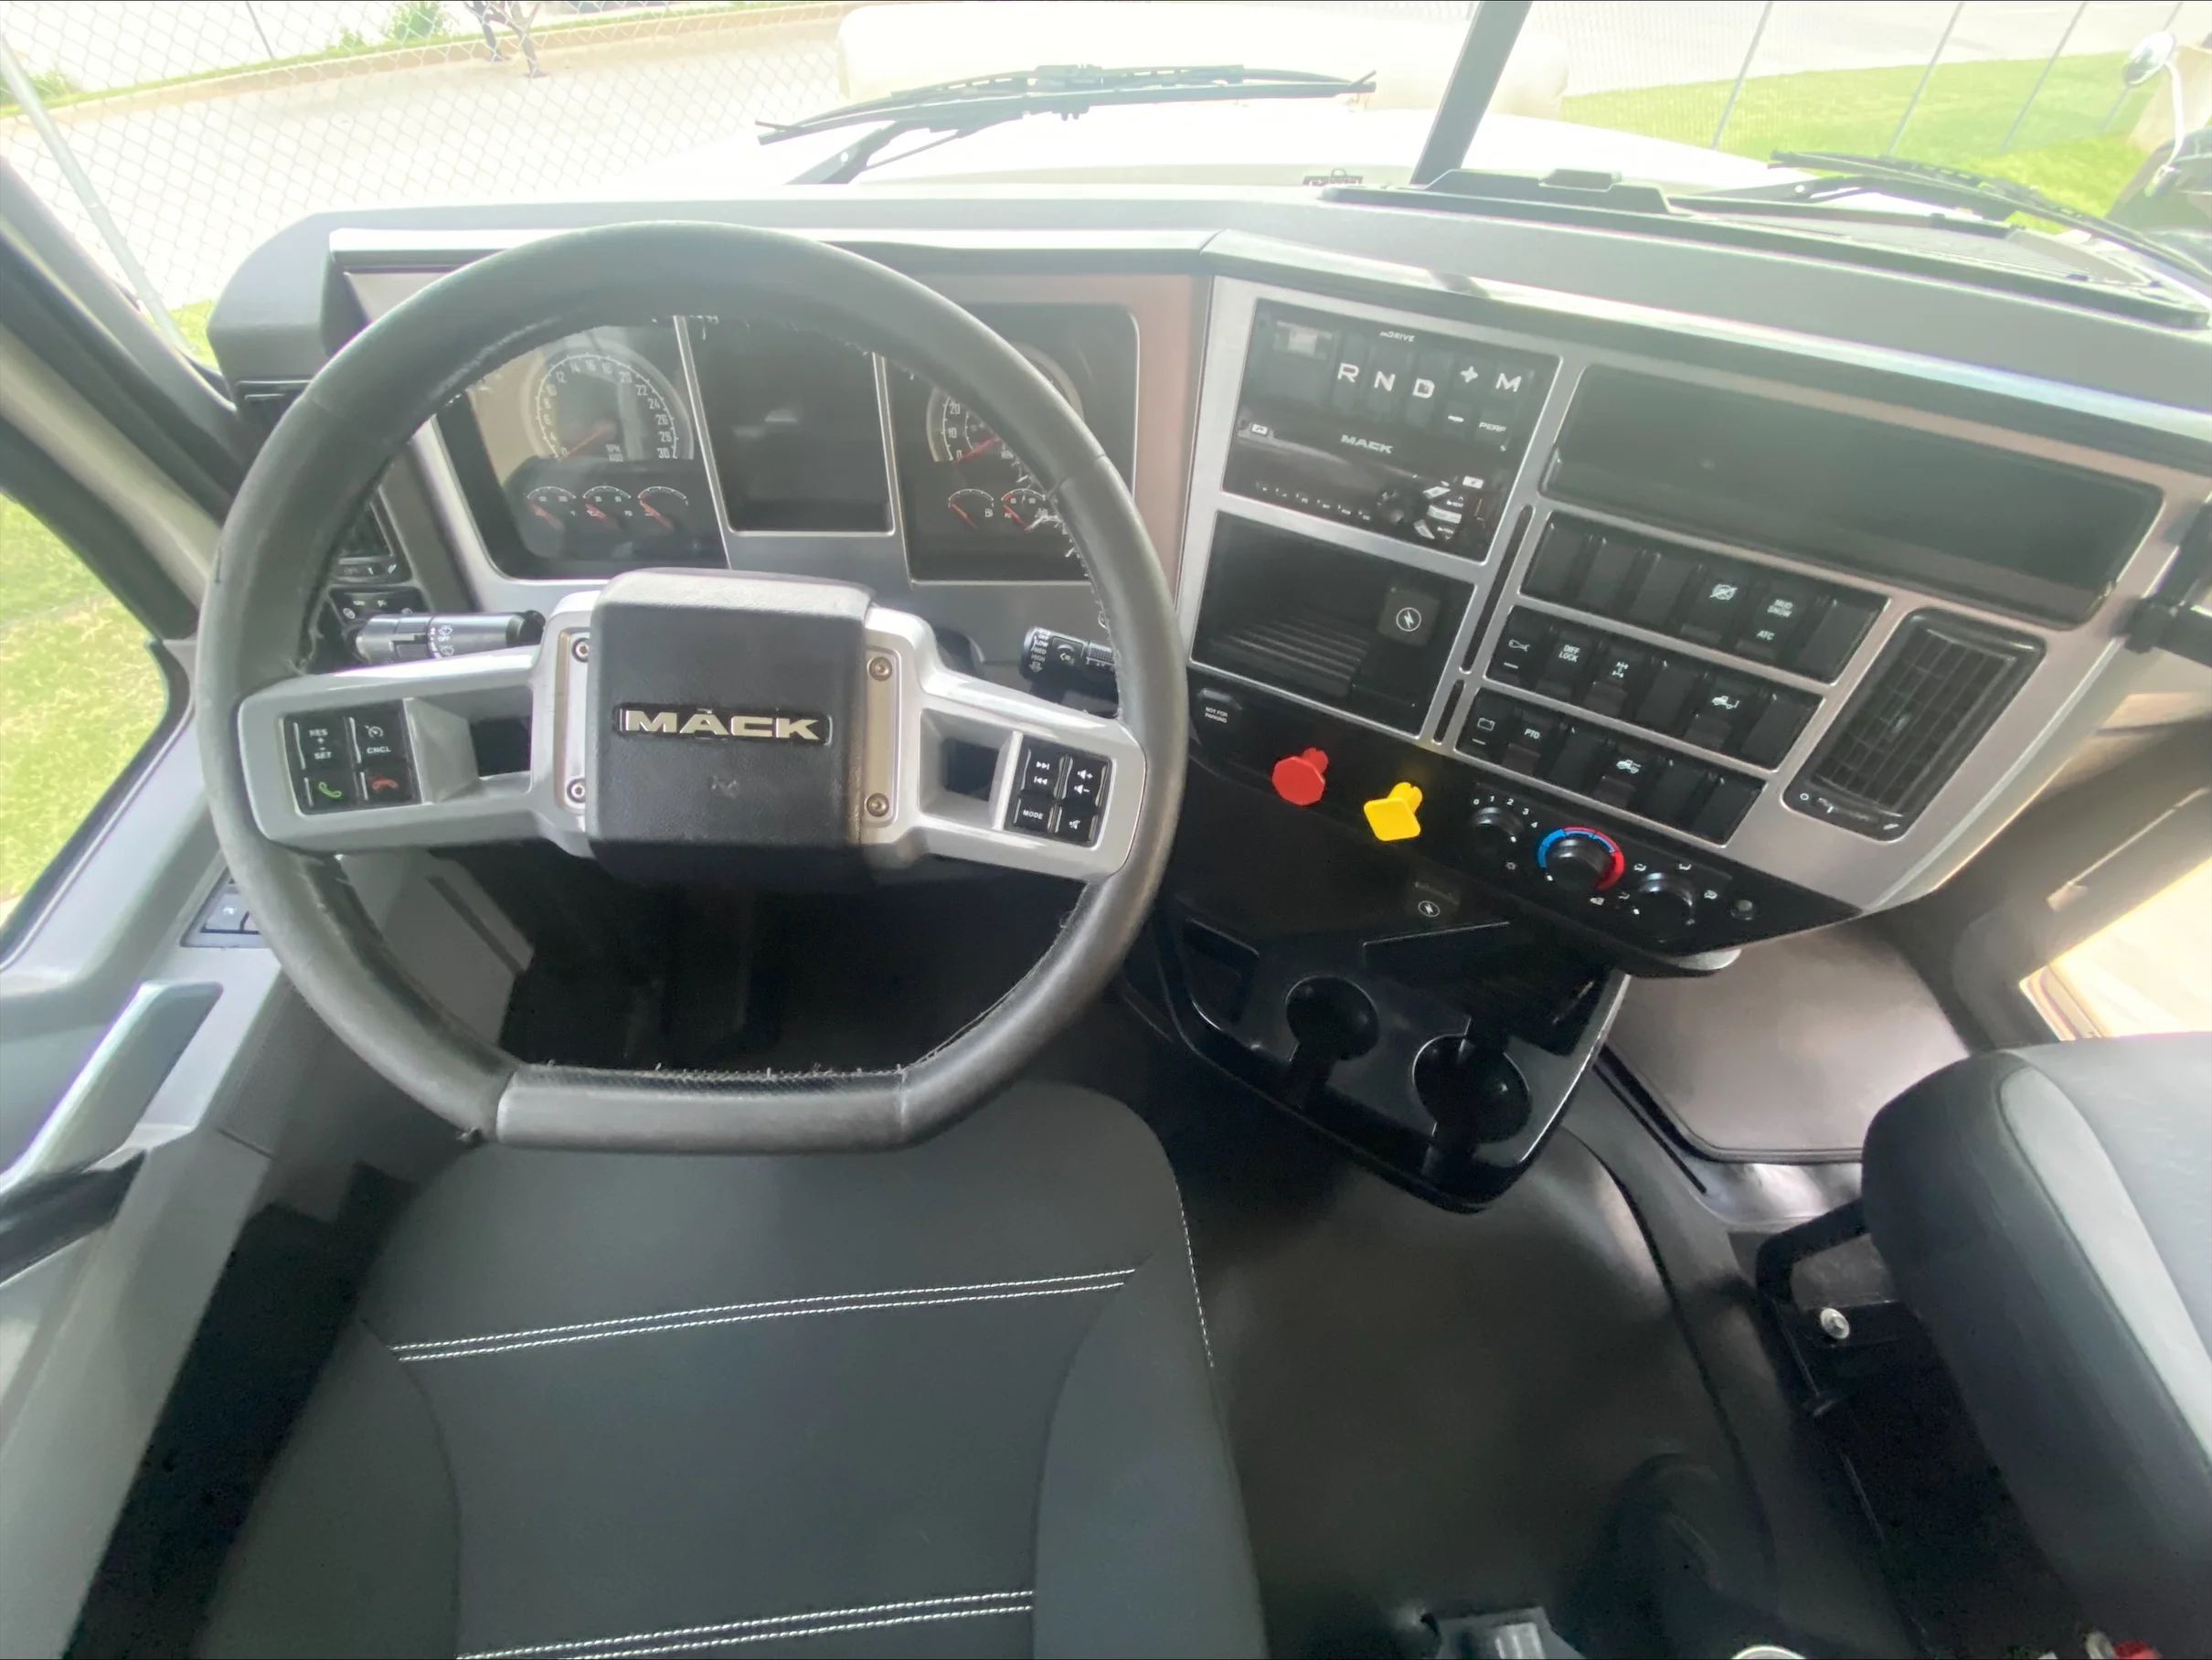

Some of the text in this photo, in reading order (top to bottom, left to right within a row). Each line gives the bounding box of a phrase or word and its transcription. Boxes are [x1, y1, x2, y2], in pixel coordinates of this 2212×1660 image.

[1337, 363, 1360, 382] R
[1374, 370, 1396, 391] N
[1412, 378, 1435, 399] D
[1495, 372, 1521, 392] M
[635, 384, 648, 396] 22
[647, 398, 660, 410] 24
[949, 402, 961, 414] 20
[655, 414, 669, 425] 26
[1479, 421, 1506, 432] PERF
[658, 431, 673, 442] 28
[1341, 434, 1394, 454] MACK
[657, 447, 670, 459] 30
[1757, 630, 1775, 641] ATC
[1563, 644, 1581, 654] DIFF
[1558, 651, 1579, 663] LOCK
[625, 709, 821, 740] MACK
[309, 729, 329, 738] RES
[1524, 728, 1541, 740] PTO
[314, 751, 332, 760] SET
[367, 746, 391, 754] CNCL
[1023, 809, 1044, 820] MODE
